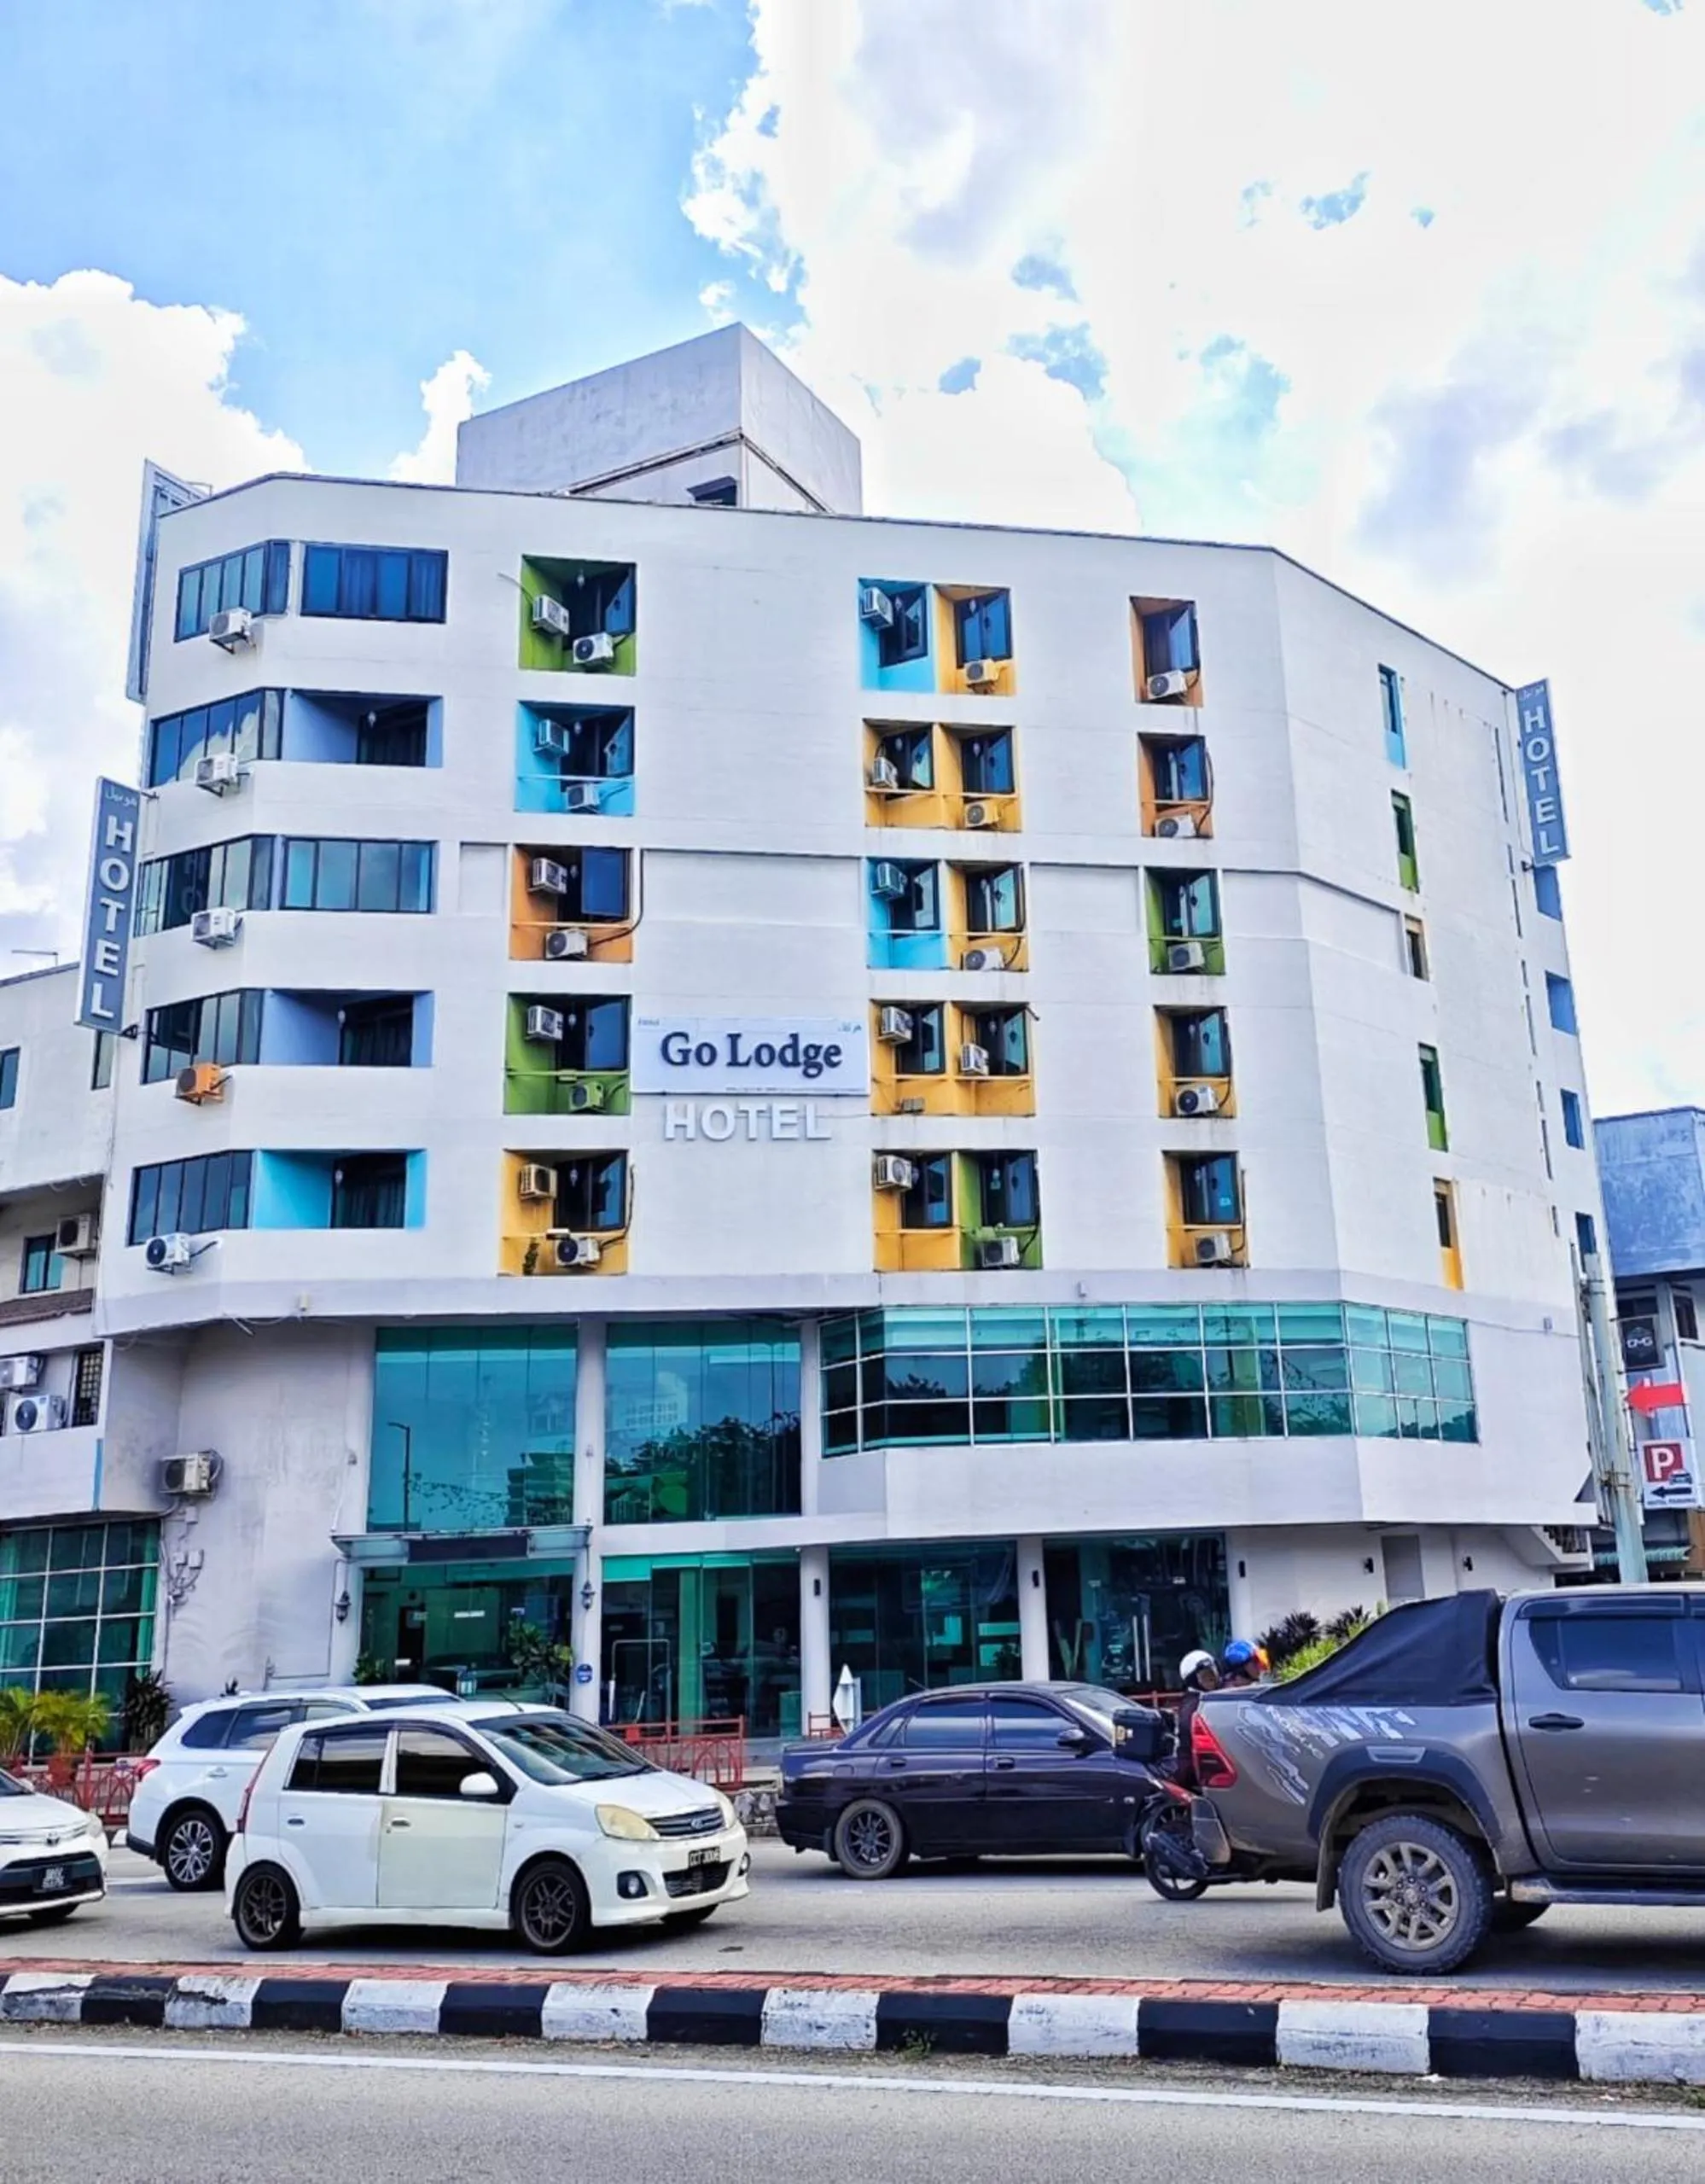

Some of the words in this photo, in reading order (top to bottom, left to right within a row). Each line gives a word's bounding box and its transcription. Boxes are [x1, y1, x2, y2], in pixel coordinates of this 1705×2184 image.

[1522, 705, 1560, 854] HOTEL
[90, 815, 133, 1020] HOTEL
[660, 1031, 718, 1067] Go
[726, 1032, 842, 1079] Lodge
[664, 1101, 831, 1141] HOTEL
[1650, 1447, 1674, 1479] P
